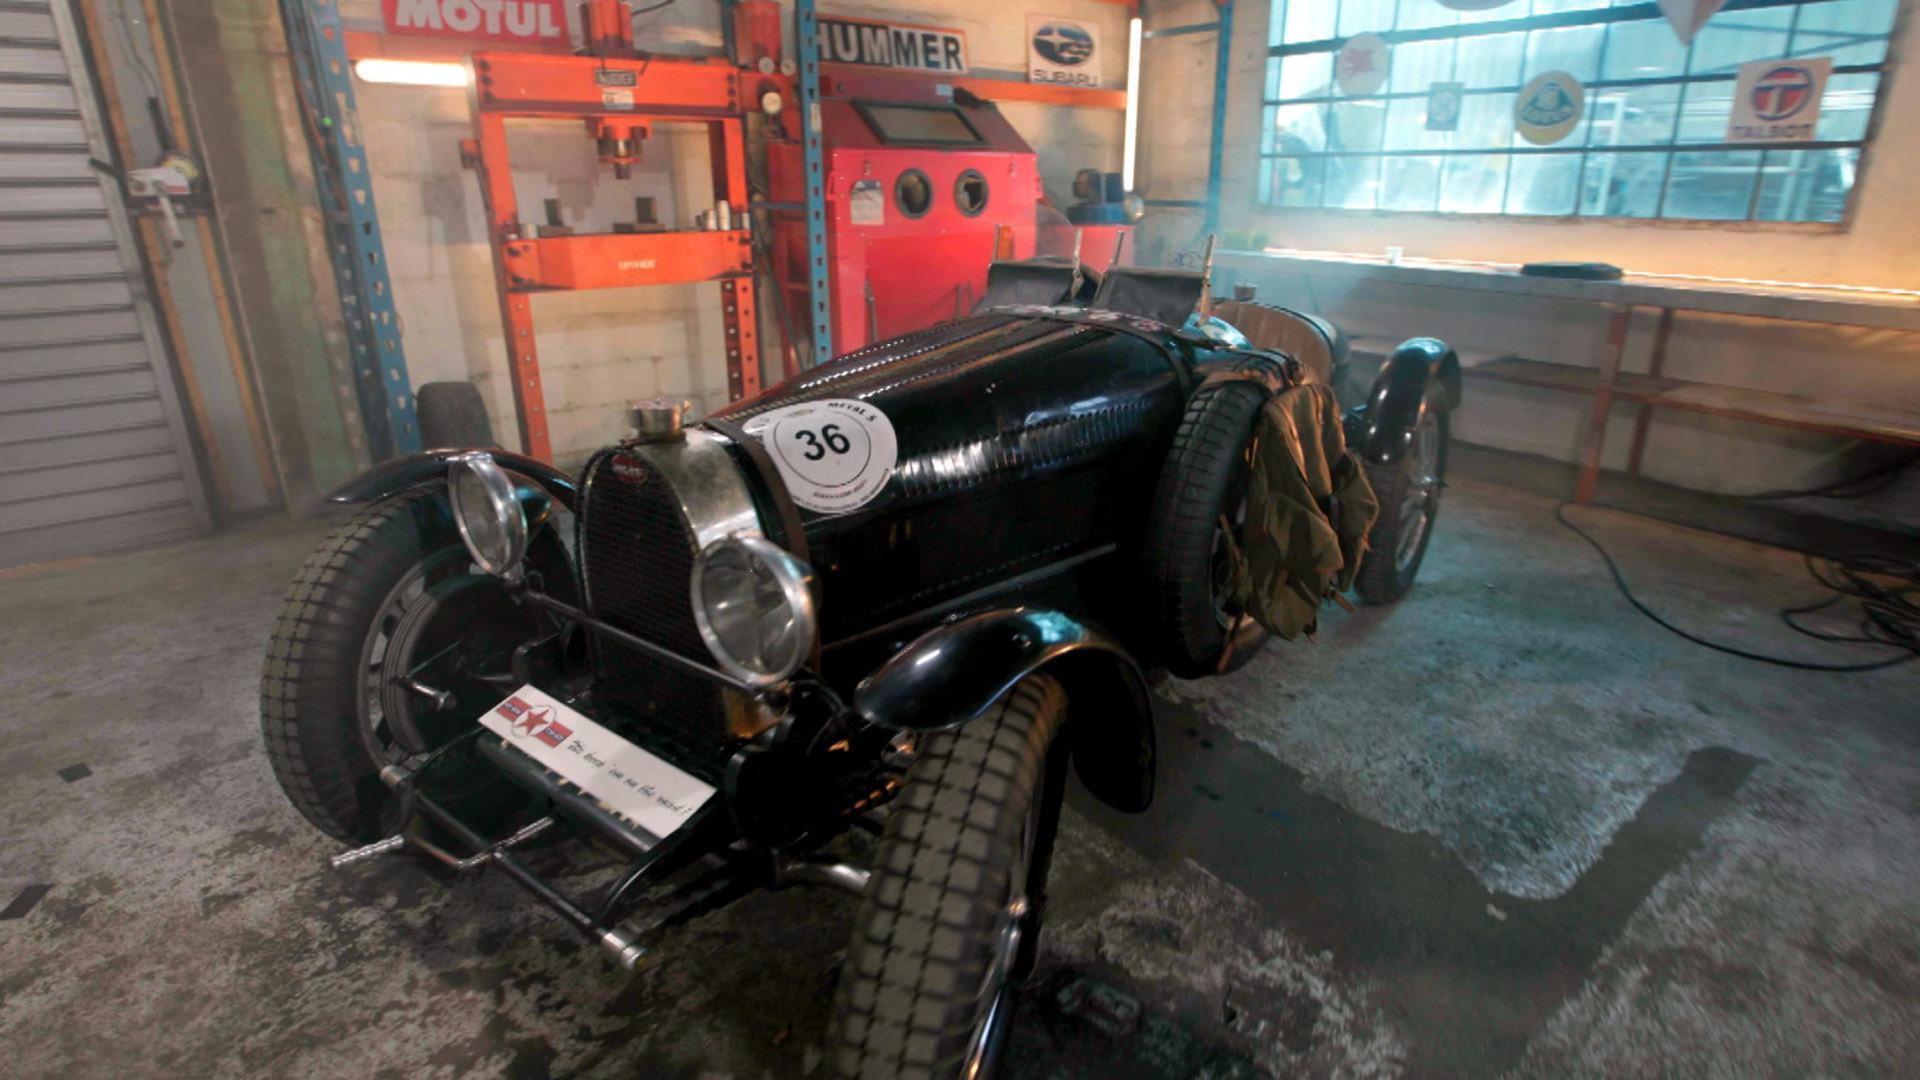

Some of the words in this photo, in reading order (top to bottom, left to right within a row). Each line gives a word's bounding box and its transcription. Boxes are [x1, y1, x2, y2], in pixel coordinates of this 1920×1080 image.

[395, 0, 560, 37] MOTUL
[1033, 69, 1099, 87] SUBARU
[1731, 124, 1814, 138] TALBOT
[795, 424, 850, 461] 36
